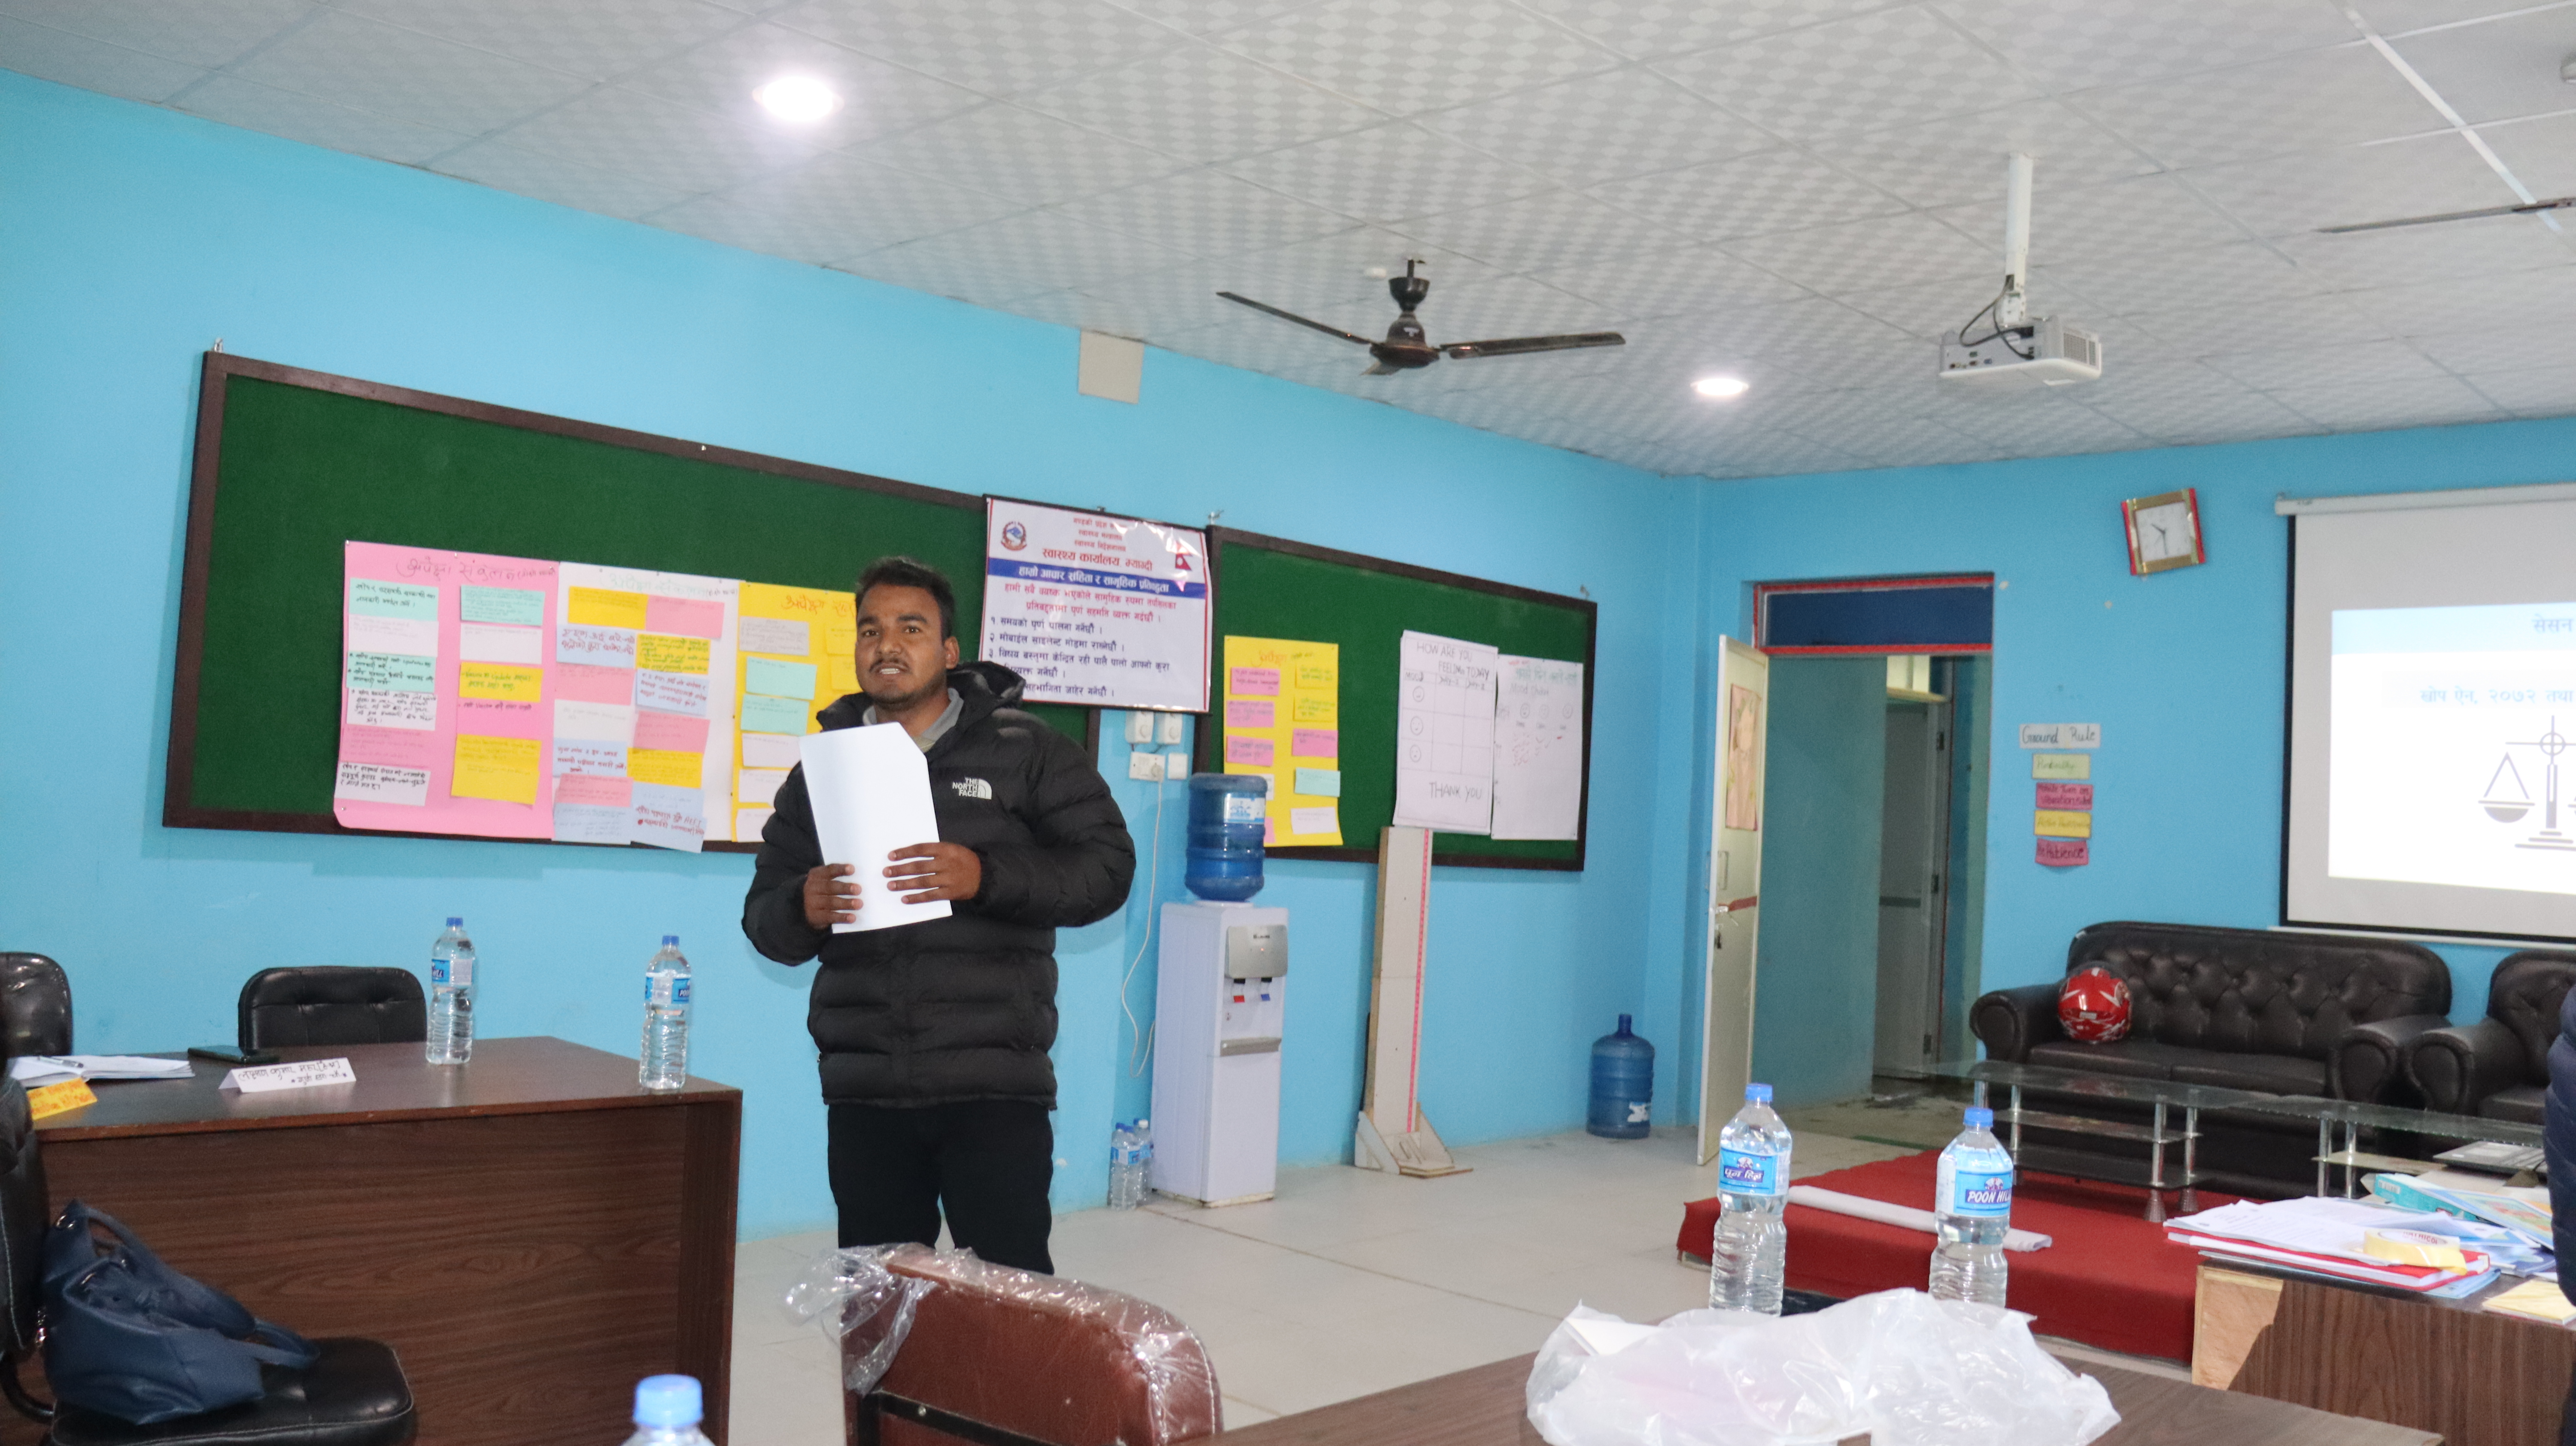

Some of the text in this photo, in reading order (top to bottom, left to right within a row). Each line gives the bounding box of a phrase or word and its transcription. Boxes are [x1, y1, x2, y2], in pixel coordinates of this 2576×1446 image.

[1043, 548, 1075, 560] स्वास्थ्य
[1095, 575, 1101, 584] र
[1005, 582, 1021, 592] हामी
[1417, 642, 1472, 662] HOW ARE YOU
[2488, 689, 2536, 704] २०७२
[2069, 725, 2095, 741] Rule
[952, 781, 978, 791] NORTH
[1429, 781, 1482, 802] THANK YOU
[959, 789, 978, 797] FACE
[1724, 1168, 1743, 1179] पून
[1967, 1191, 1996, 1203] POON
